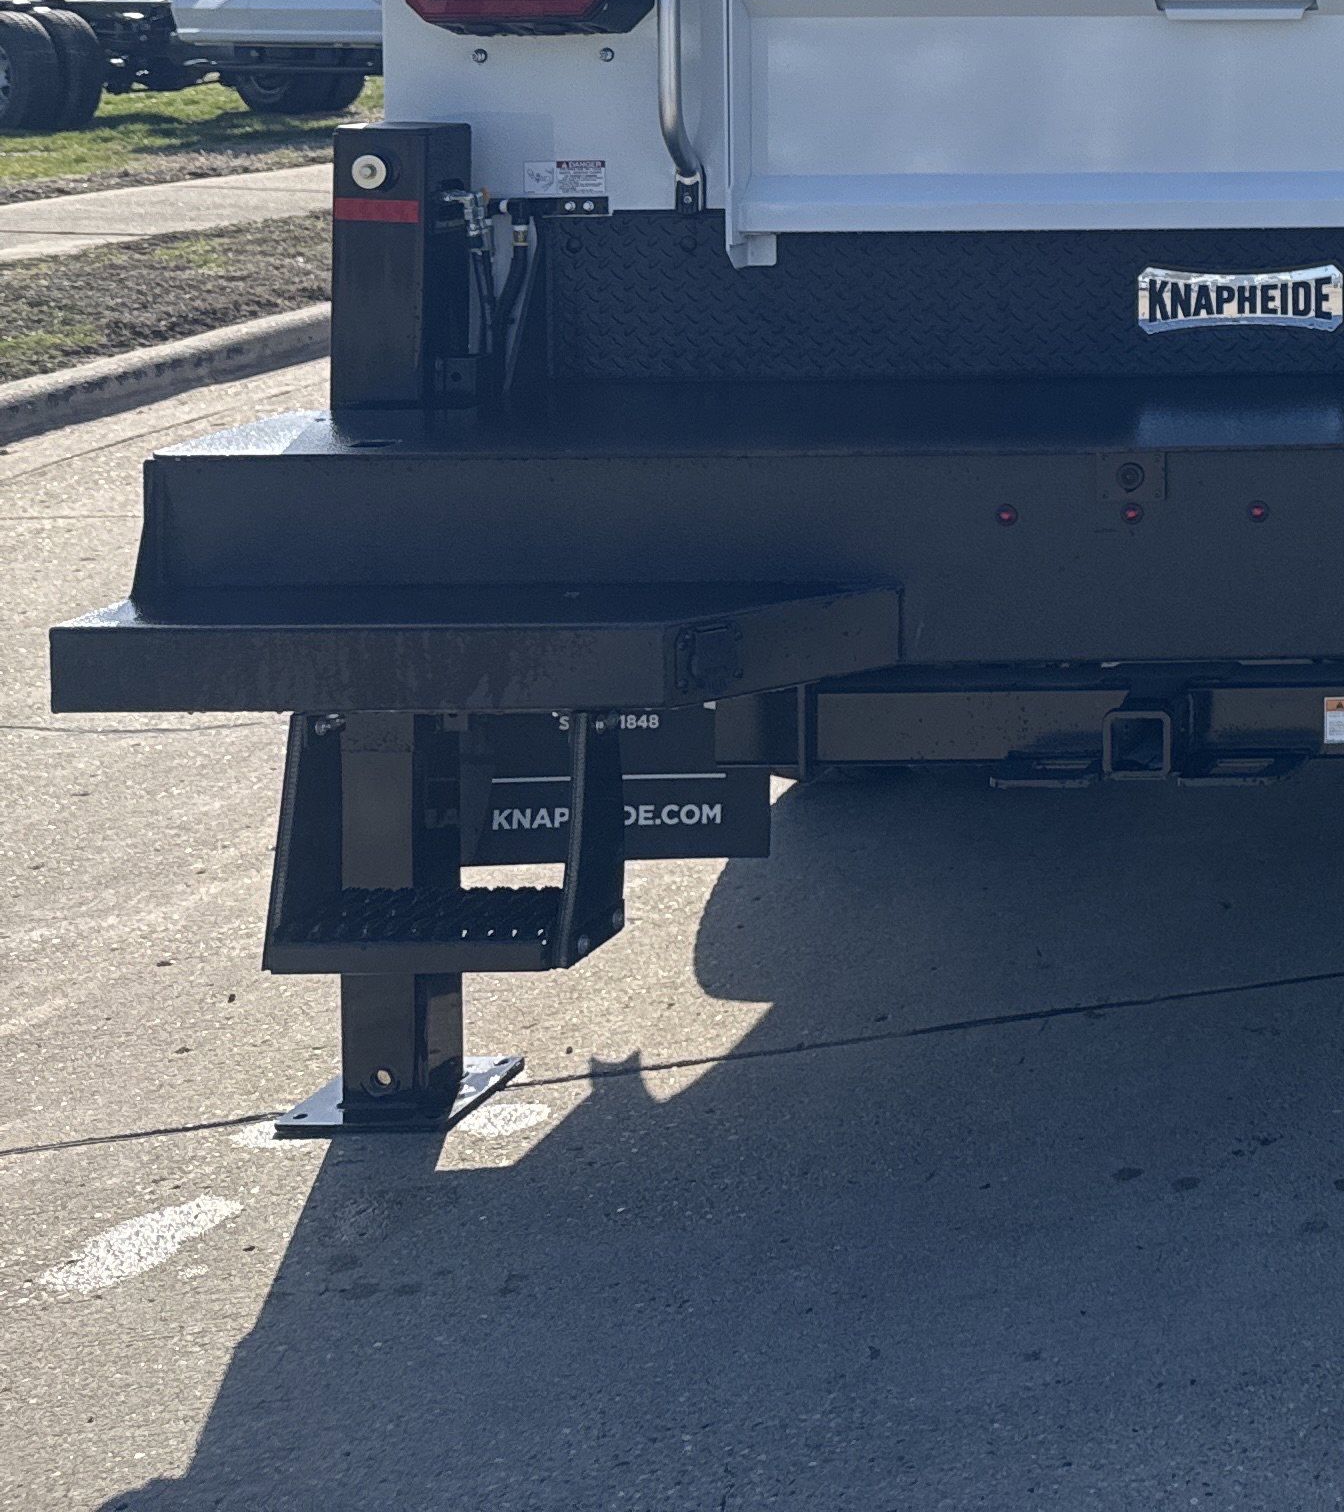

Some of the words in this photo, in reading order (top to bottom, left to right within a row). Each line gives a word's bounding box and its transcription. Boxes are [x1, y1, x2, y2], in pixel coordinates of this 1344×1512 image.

[1148, 276, 1332, 323] KNAPHEIDE
[620, 714, 659, 729] 1848
[492, 803, 722, 830] KNAPDE.COM
